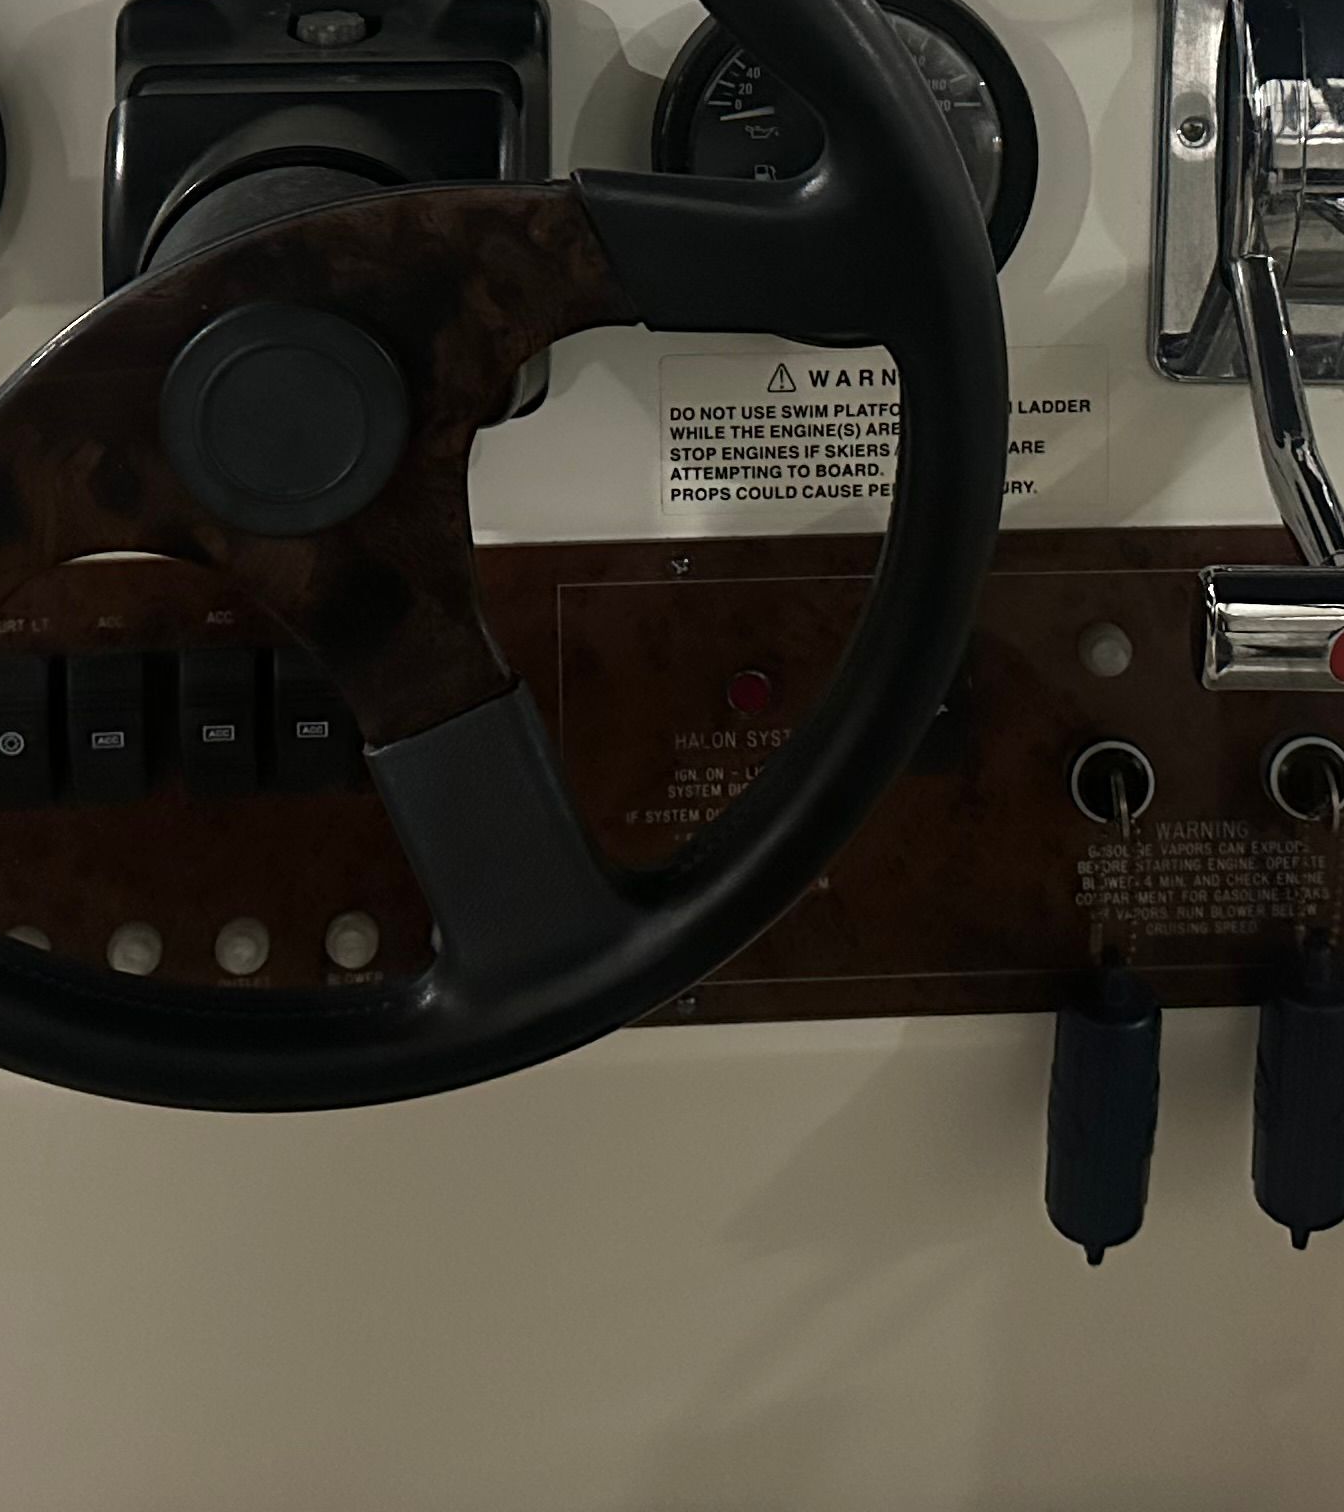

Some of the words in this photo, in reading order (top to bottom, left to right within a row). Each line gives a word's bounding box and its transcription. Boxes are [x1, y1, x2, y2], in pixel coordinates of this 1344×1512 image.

[746, 66, 761, 79] 40
[738, 82, 753, 95] 20
[734, 98, 743, 111] 0
[809, 369, 897, 388] WARN
[670, 407, 695, 421] DO
[700, 406, 738, 420] NOT
[741, 406, 777, 419] USE
[781, 404, 829, 418] SWIM
[834, 402, 902, 417] PLATFO
[1018, 399, 1091, 414] LADDER
[670, 425, 726, 440] WHILE
[731, 424, 764, 438] THE
[770, 423, 861, 440] ENGINE(S)
[866, 422, 901, 436] ARE
[670, 447, 716, 461] STOP
[721, 445, 799, 460] ENGINES
[805, 445, 820, 458] IF
[825, 443, 890, 458] SKIERS
[1008, 440, 1045, 455] ARE
[670, 465, 782, 481] ATTEMPTING
[787, 465, 810, 479] TO
[816, 463, 884, 478] BOARD.
[671, 488, 731, 502] PROPS
[736, 486, 797, 500] COULD
[802, 484, 863, 499] CAUSE
[674, 731, 736, 750] HALON
[746, 728, 792, 748] SYST
[705, 767, 724, 781] ON
[667, 783, 721, 798] SYSTEM
[645, 808, 700, 823] SYSTEM
[1155, 820, 1249, 839] WARNING
[1160, 842, 1212, 856] VAPORS
[1218, 841, 1245, 854] CAN
[1193, 874, 1220, 887] AND
[1226, 873, 1269, 886] CHECK
